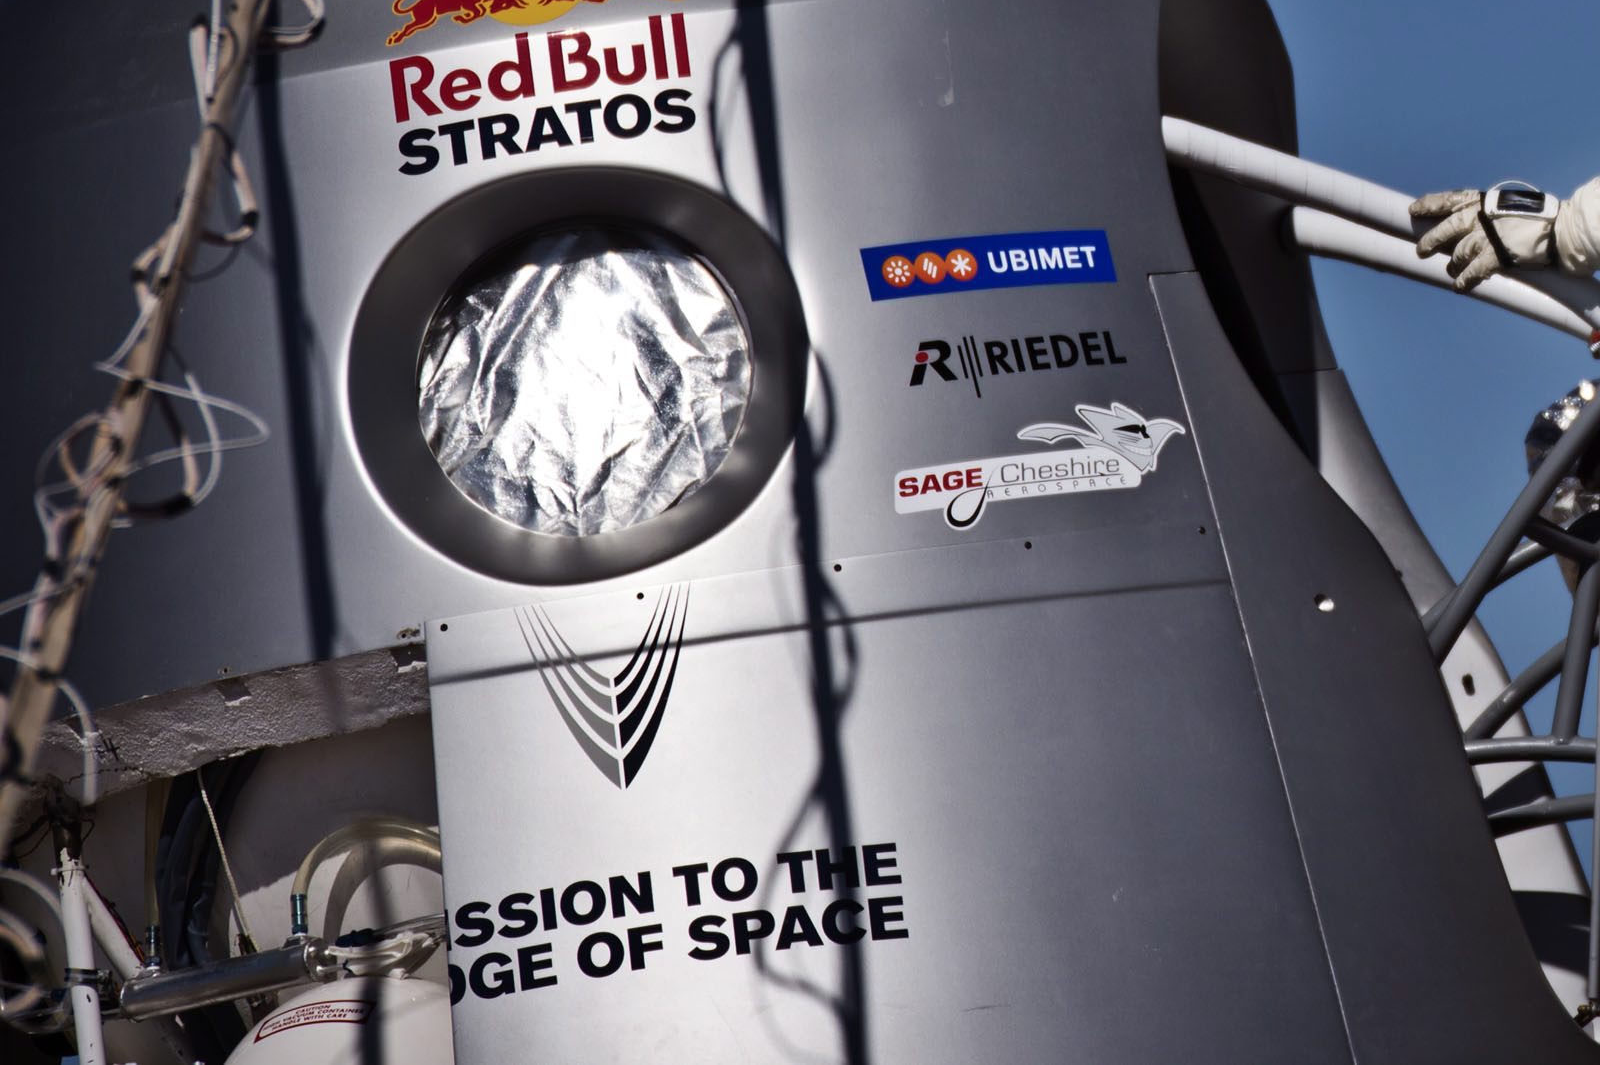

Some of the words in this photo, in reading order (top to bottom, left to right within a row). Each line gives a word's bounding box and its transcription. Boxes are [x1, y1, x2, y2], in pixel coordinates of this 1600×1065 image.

[389, 32, 536, 124] Red
[547, 12, 692, 94] Bull
[397, 88, 697, 176] STRATOS
[987, 245, 1097, 274] UBIMET
[983, 330, 1128, 376] RIEDEL
[898, 467, 984, 498] SAGE
[999, 455, 1121, 485] Cheshire
[986, 475, 1128, 500] AEROSPACE
[672, 856, 760, 908] TO
[776, 842, 903, 895] THE
[576, 923, 664, 979] OF
[687, 895, 910, 961] SPACE
